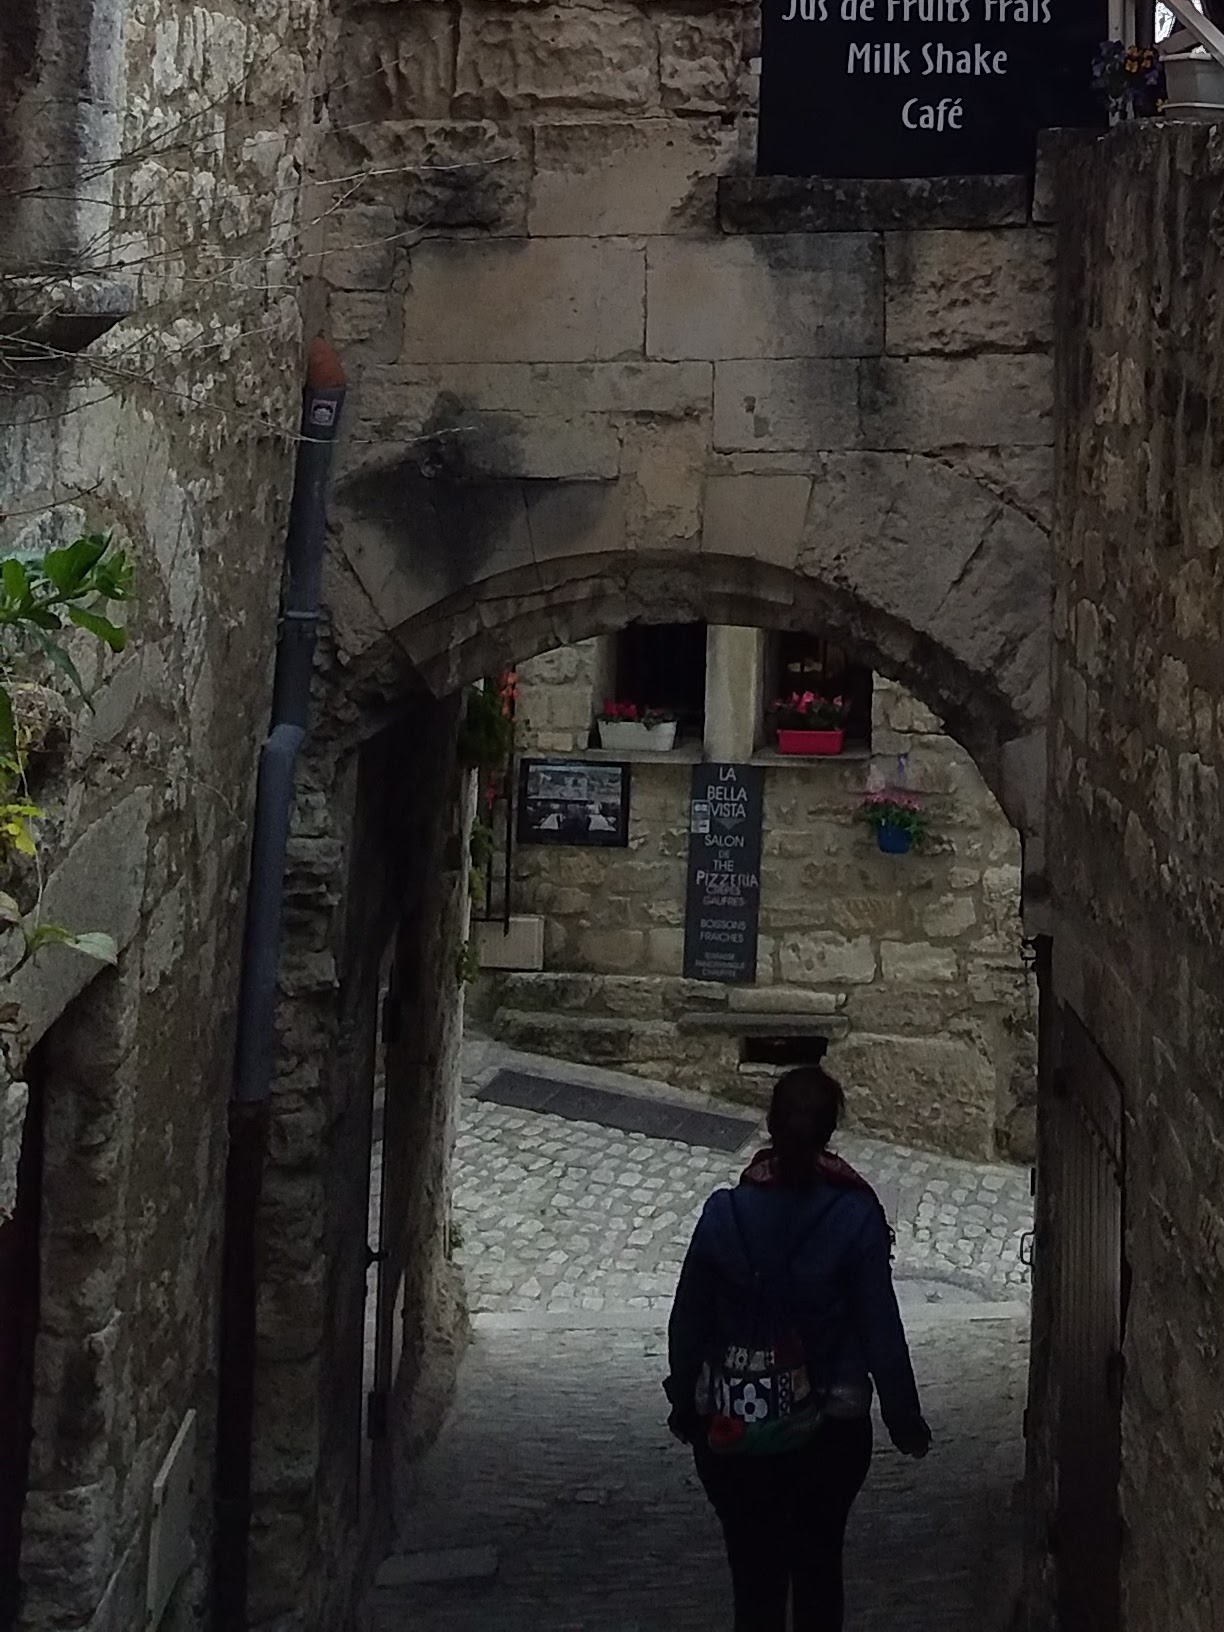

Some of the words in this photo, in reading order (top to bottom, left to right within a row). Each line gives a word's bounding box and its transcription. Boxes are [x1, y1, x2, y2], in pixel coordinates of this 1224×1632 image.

[847, 43, 911, 75] Milk
[921, 42, 1008, 76] Shake
[901, 97, 964, 132] Café
[719, 766, 737, 782] LA
[706, 784, 748, 802] BELLA
[709, 802, 747, 818] VISTA
[704, 834, 745, 847] SALON
[713, 859, 734, 872] THE
[695, 869, 759, 888] PIZZERIA
